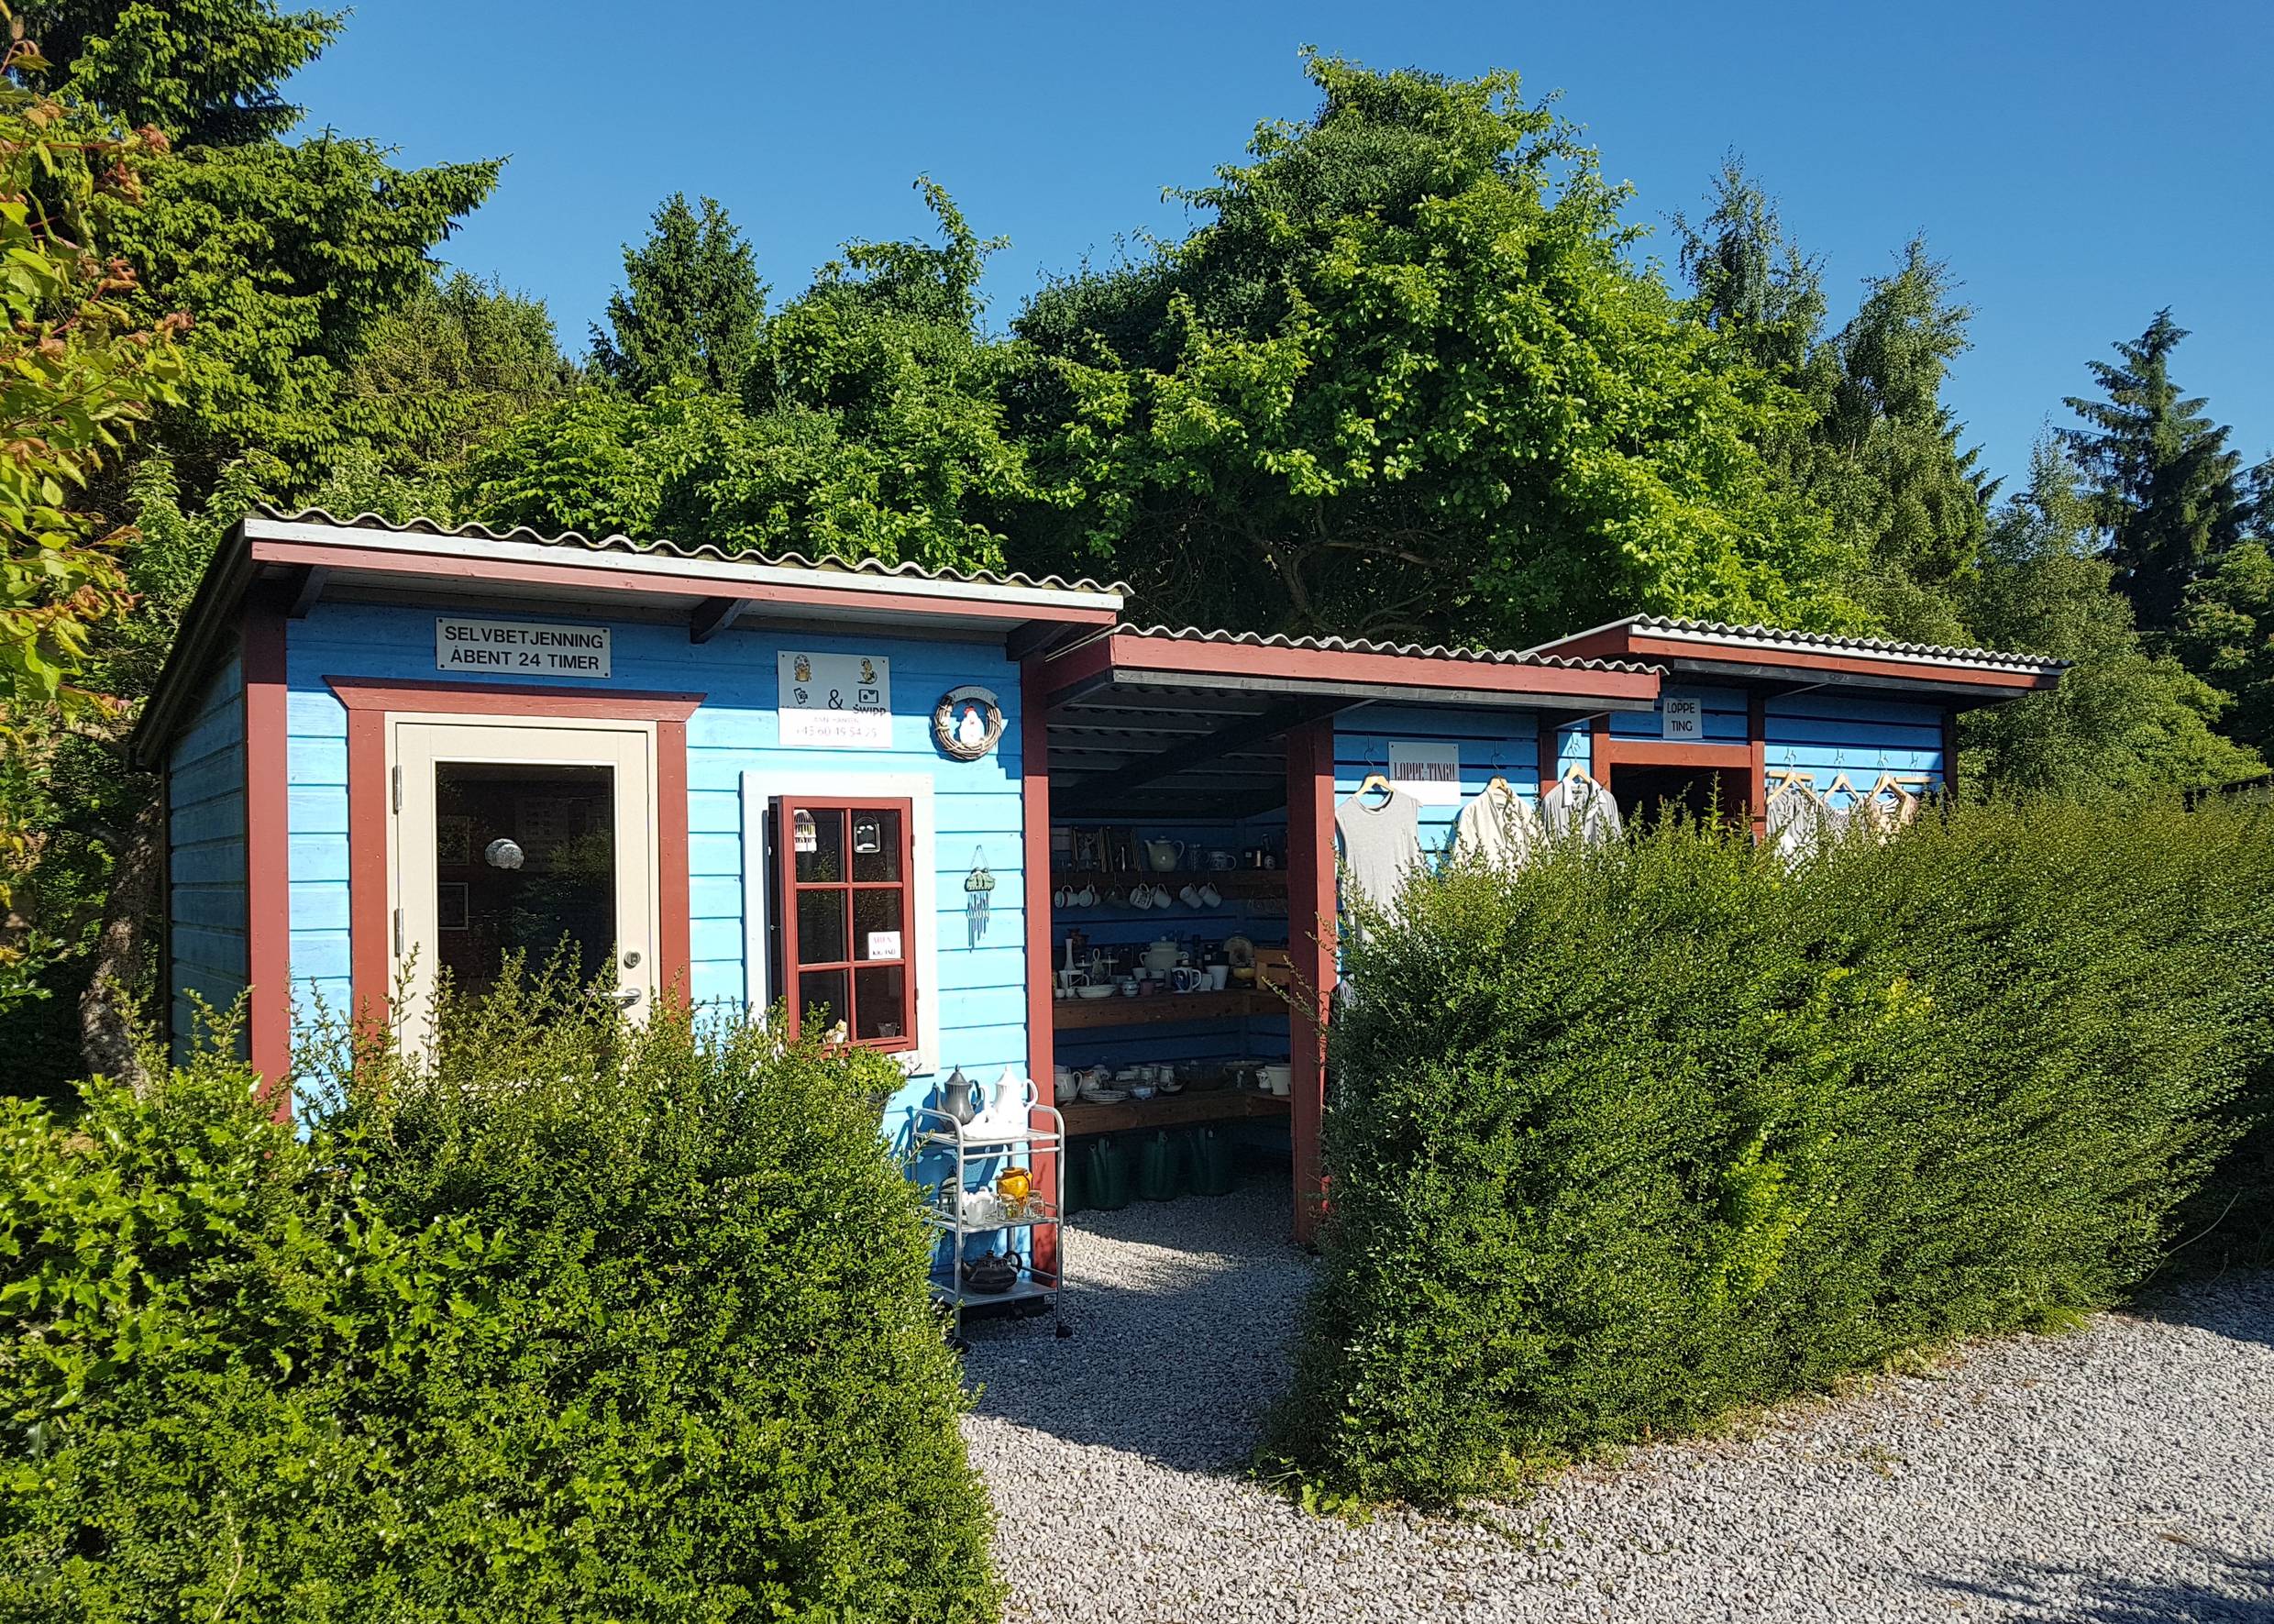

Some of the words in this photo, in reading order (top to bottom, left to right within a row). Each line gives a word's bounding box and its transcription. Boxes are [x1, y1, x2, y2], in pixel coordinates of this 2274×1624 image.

[450, 645, 513, 666] ÅBENT
[518, 652, 541, 668] 24
[547, 654, 600, 670] TIMER
[827, 689, 844, 710] &
[1666, 702, 1695, 713] LOPPE
[1671, 720, 1693, 732] TING
